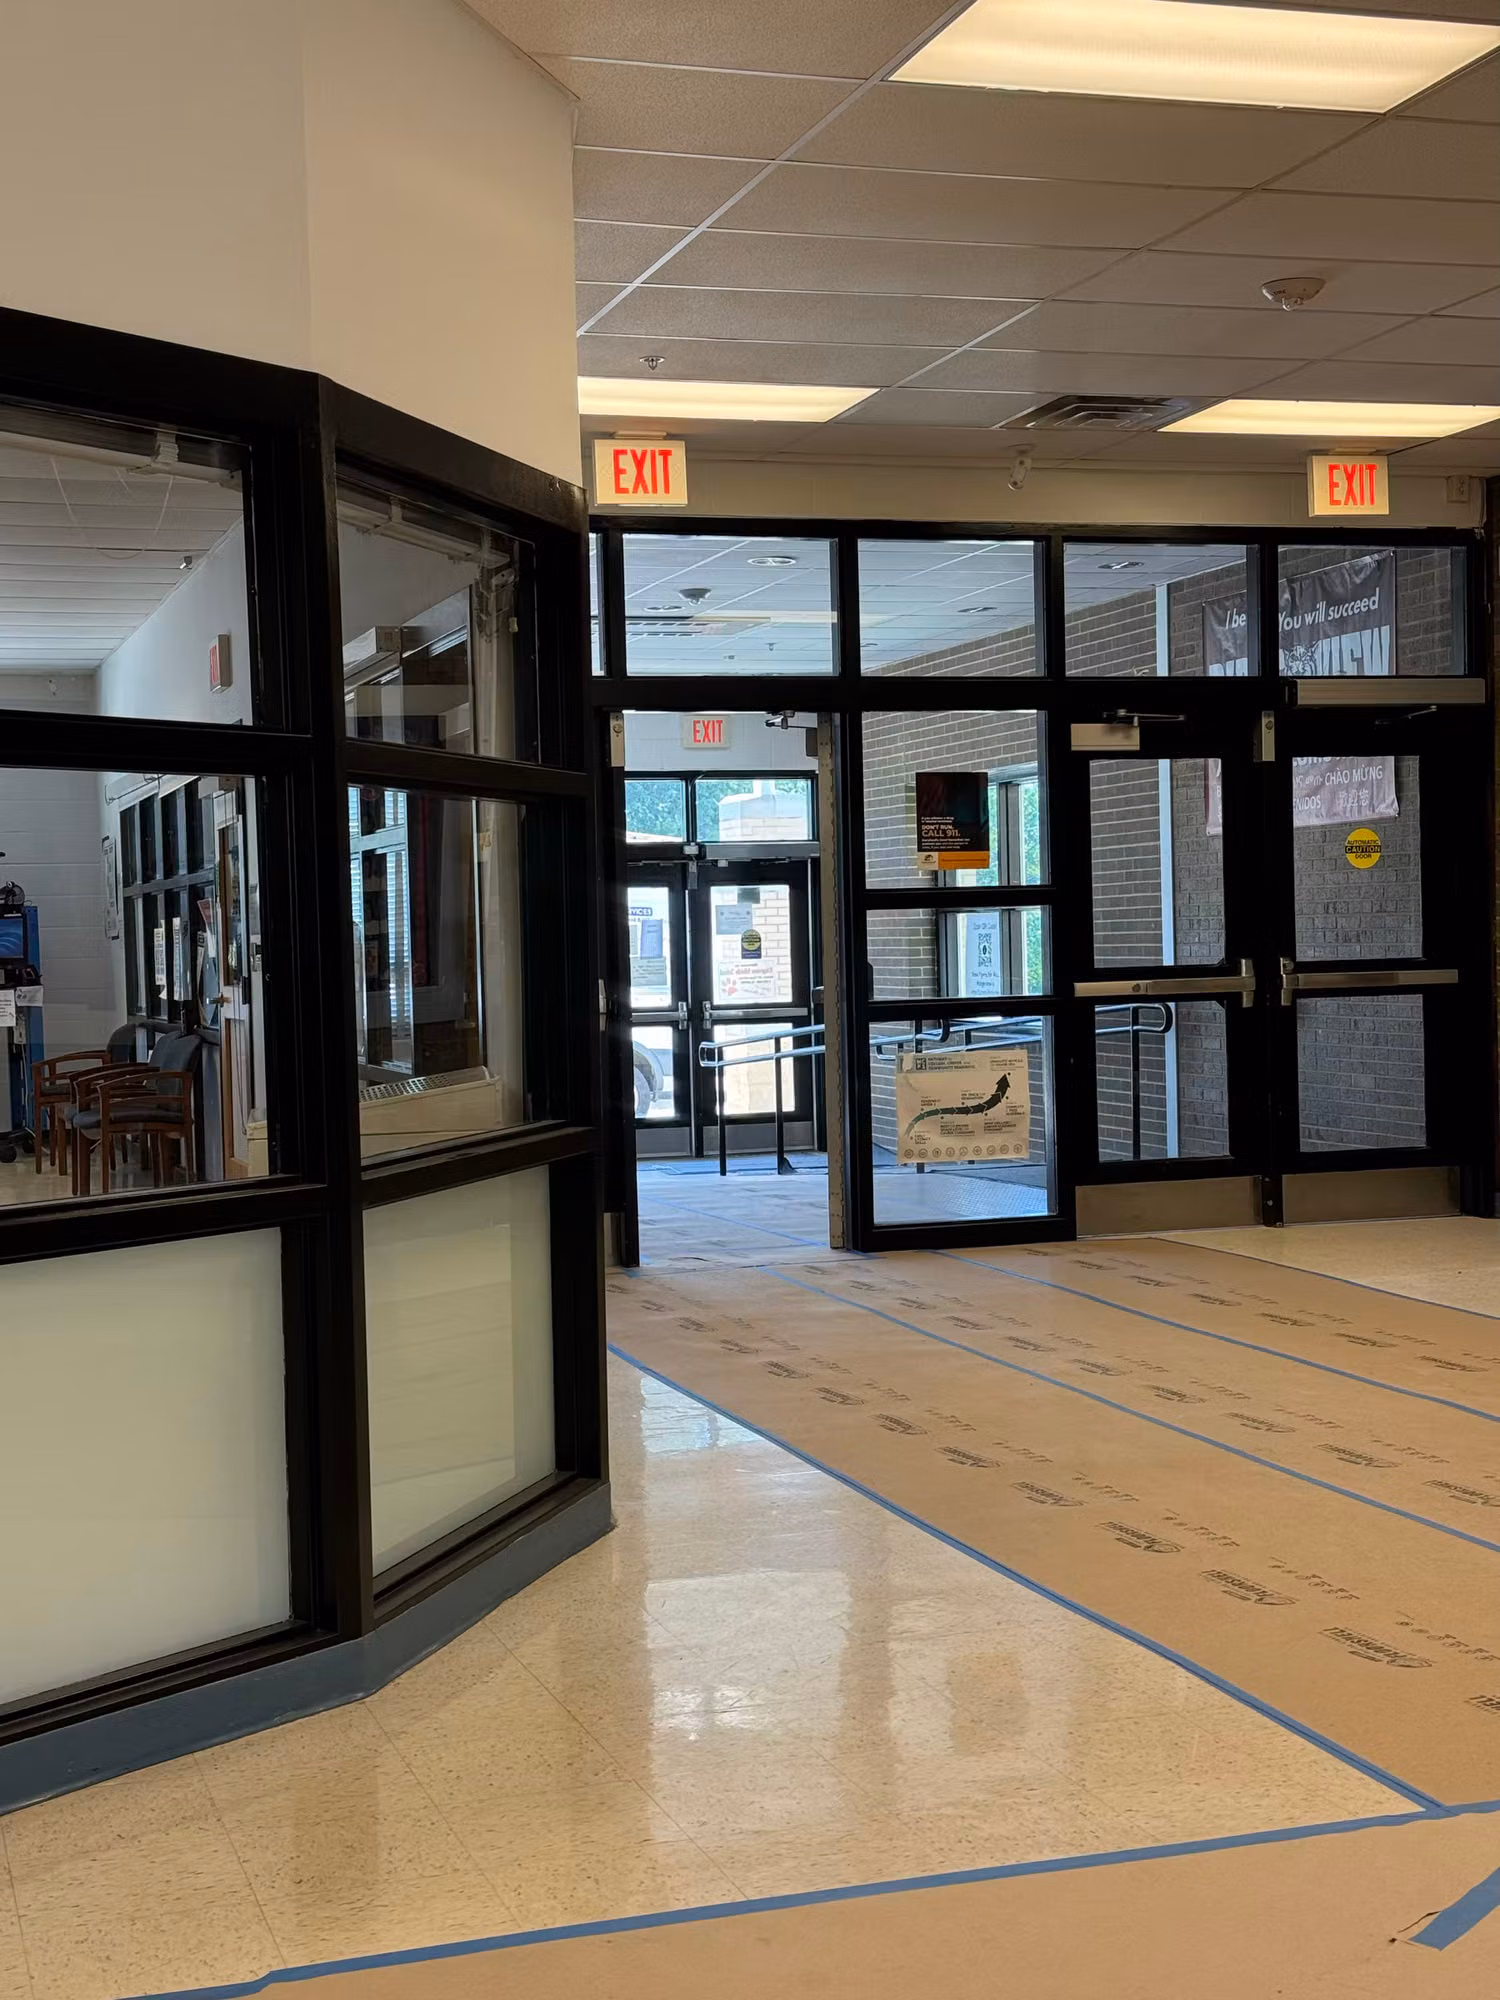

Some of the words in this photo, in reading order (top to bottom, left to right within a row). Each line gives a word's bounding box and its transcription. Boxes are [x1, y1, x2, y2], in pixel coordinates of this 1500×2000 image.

[613, 449, 672, 495] EXIT
[1328, 463, 1378, 507] EXIT
[1279, 611, 1302, 633] You
[1304, 601, 1326, 626] will
[1327, 588, 1380, 621] succeed
[692, 720, 723, 744] EXIT
[1325, 767, 1350, 786] CHÀO
[1352, 764, 1384, 783] MỪNG
[1346, 845, 1381, 853] CAUTION
